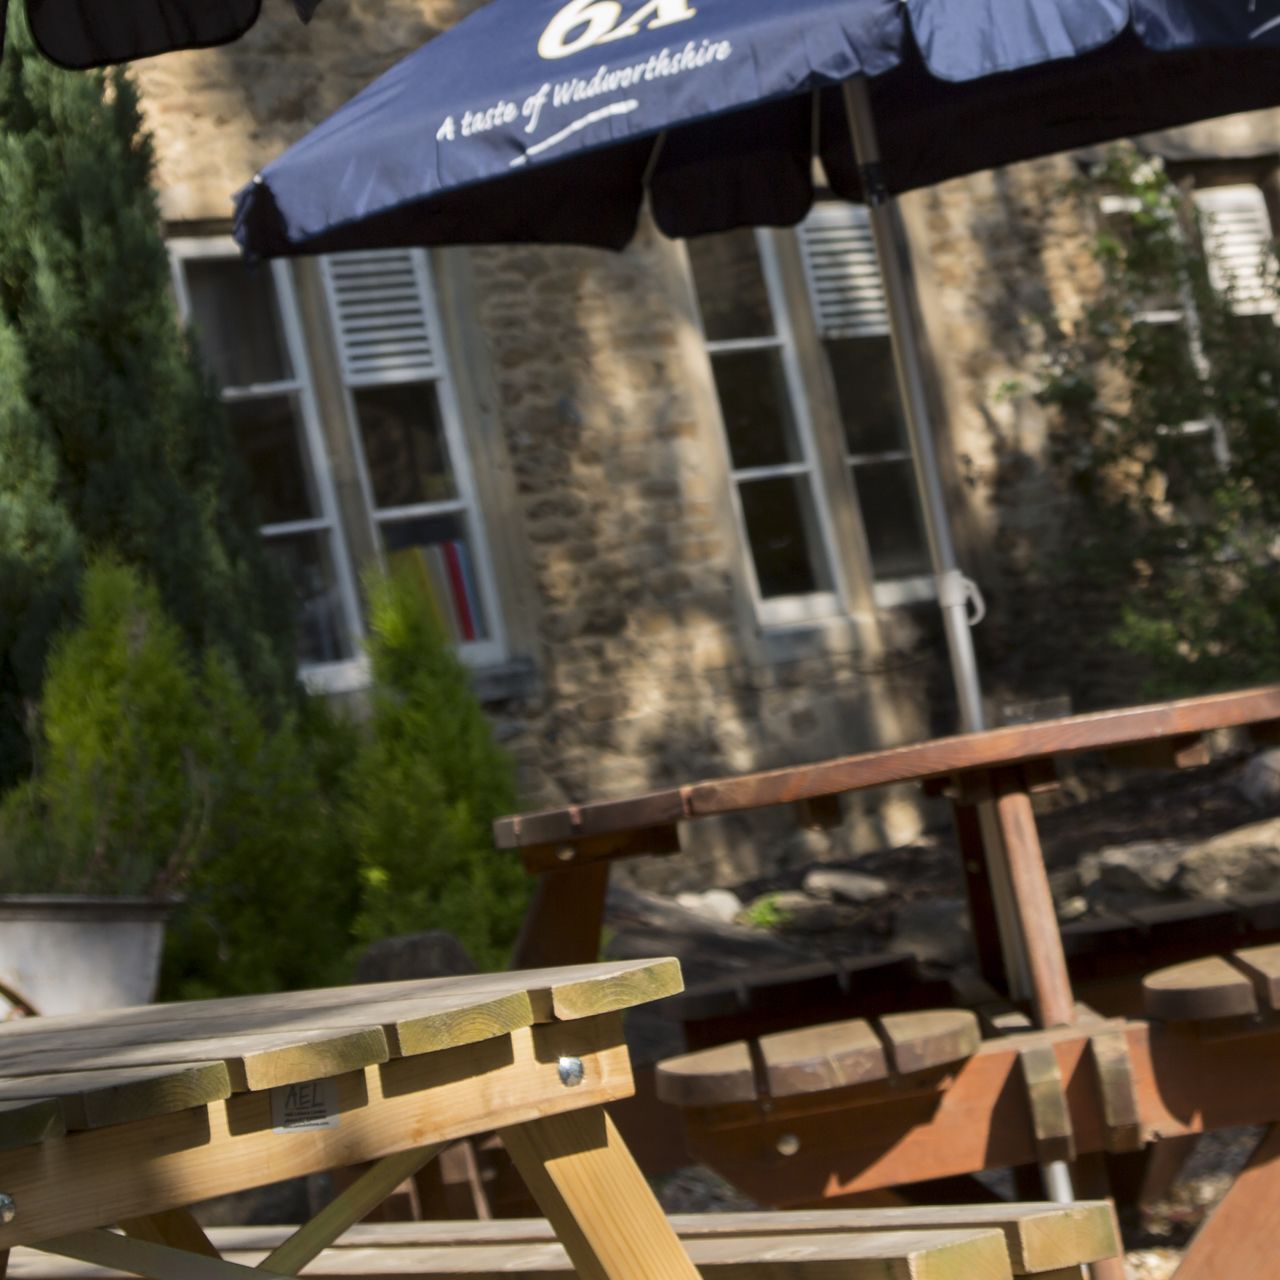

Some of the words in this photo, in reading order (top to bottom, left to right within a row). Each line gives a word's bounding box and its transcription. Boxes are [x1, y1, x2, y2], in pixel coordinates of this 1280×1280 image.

[436, 115, 455, 142] A
[461, 98, 519, 138] taste
[522, 82, 551, 133] of
[553, 37, 733, 108] Wadworthshire
